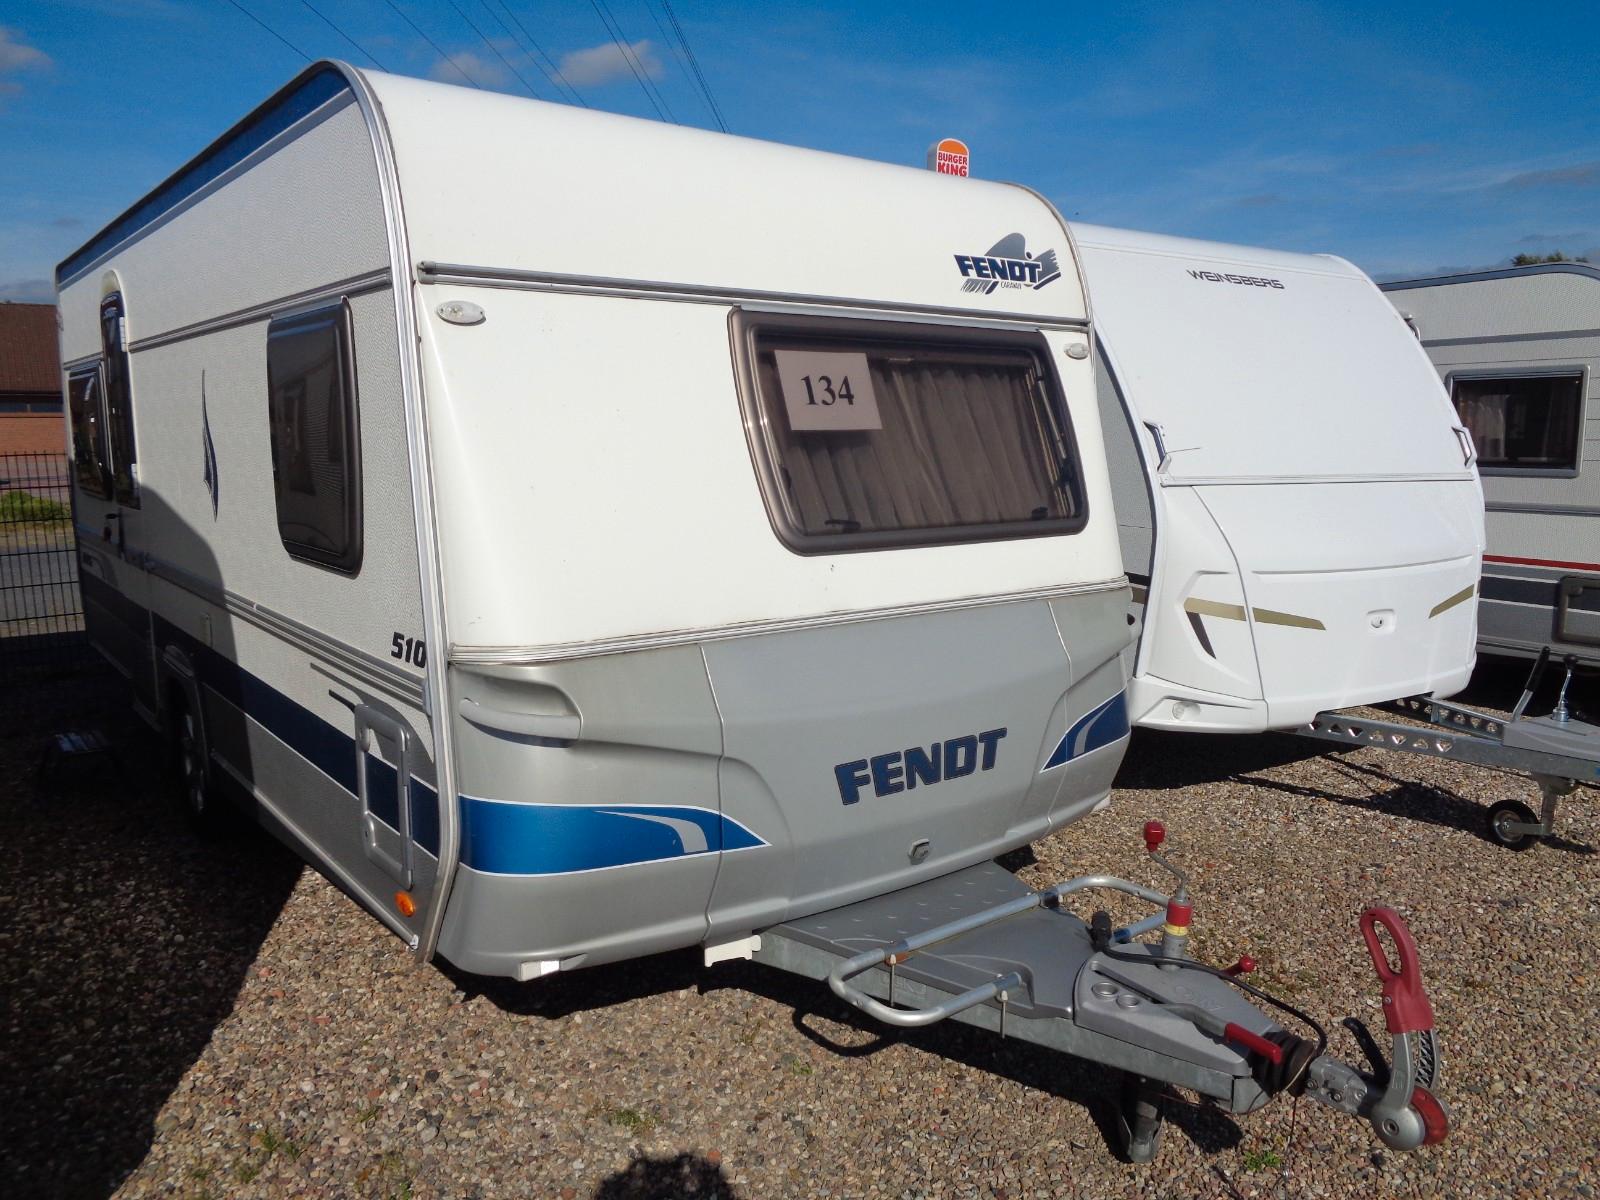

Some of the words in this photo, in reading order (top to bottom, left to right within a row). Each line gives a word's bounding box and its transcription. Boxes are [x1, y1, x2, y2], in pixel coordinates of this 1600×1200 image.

[938, 152, 968, 165] BURGER
[938, 162, 968, 177] KING
[953, 254, 1041, 284] FENDT
[1186, 268, 1285, 290] WEINSBERG
[801, 375, 855, 406] 134
[391, 631, 427, 669] 510
[834, 727, 1008, 806] FENDT
